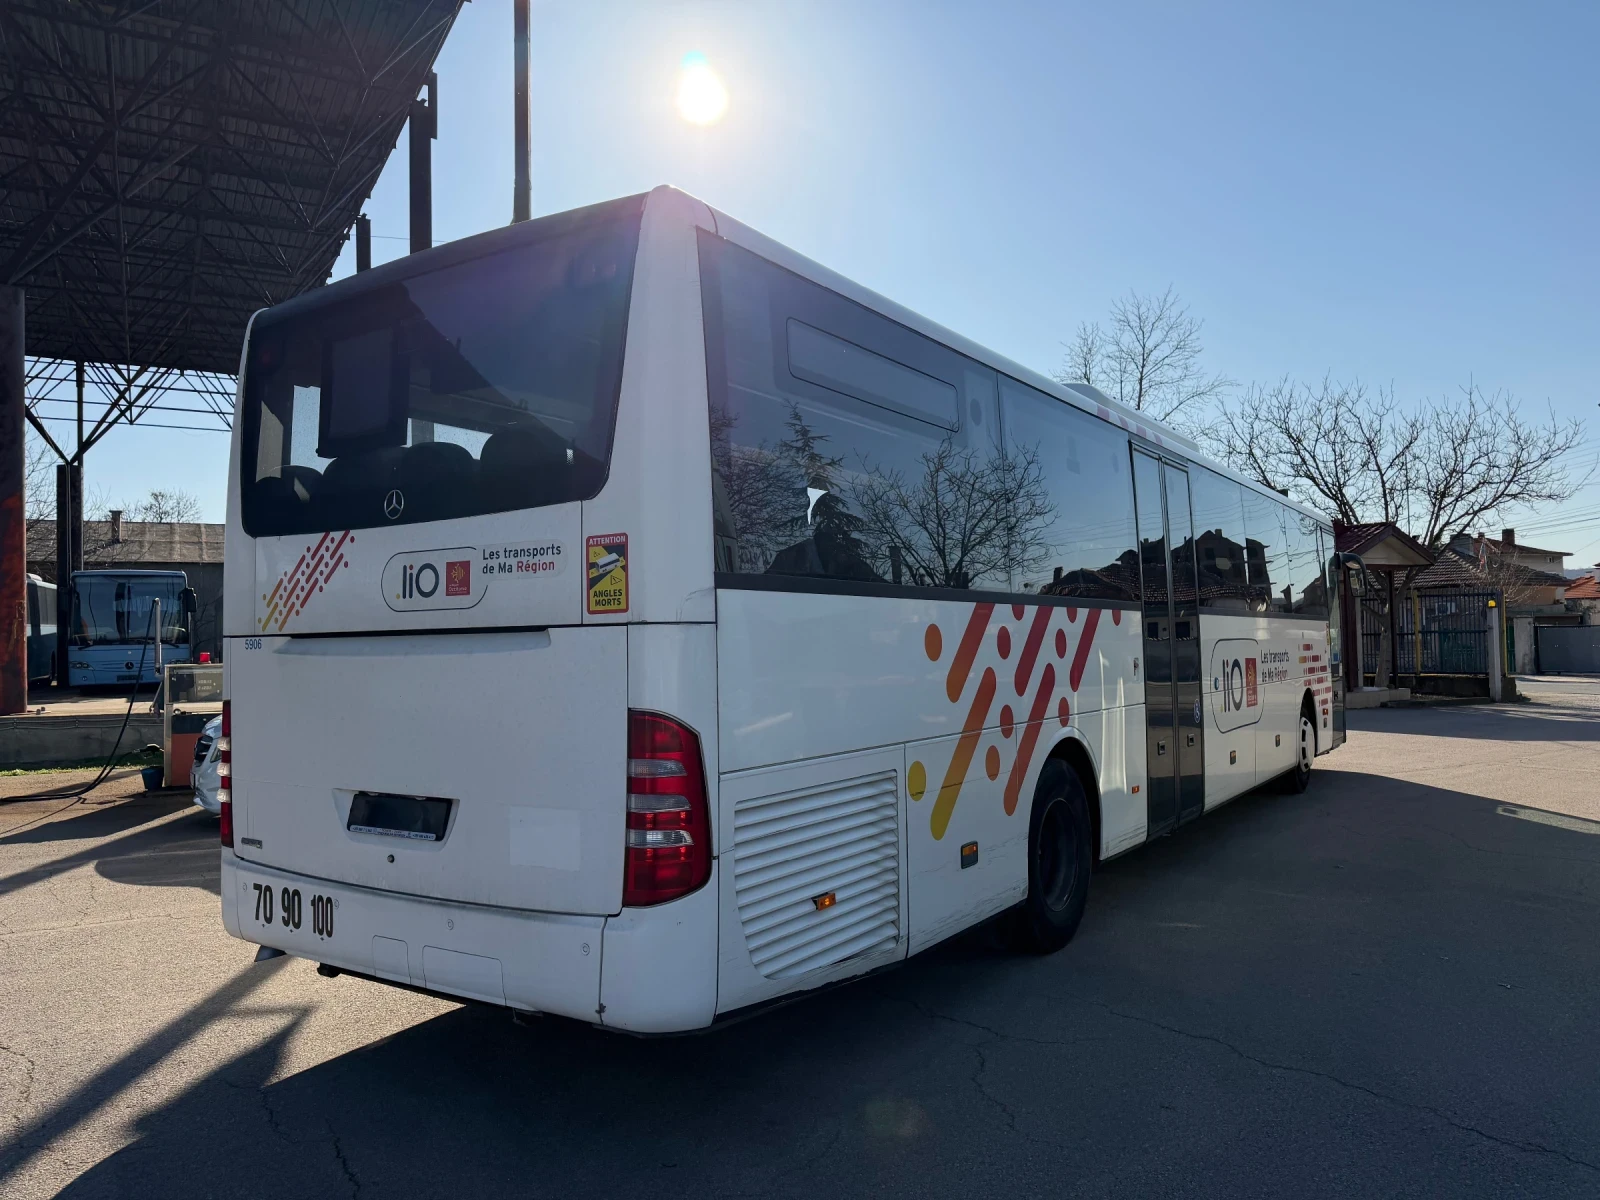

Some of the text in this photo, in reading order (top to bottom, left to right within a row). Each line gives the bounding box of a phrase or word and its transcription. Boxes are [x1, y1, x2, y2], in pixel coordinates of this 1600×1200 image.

[589, 535, 626, 545] ATTENTION
[482, 544, 562, 561] Les transports
[482, 560, 555, 574] de Ma Région
[593, 589, 623, 598] ANGLES
[594, 598, 622, 607] MORTS
[244, 638, 262, 650] 5906
[1260, 648, 1290, 665] Les transports
[253, 883, 333, 938] 70 90 100
